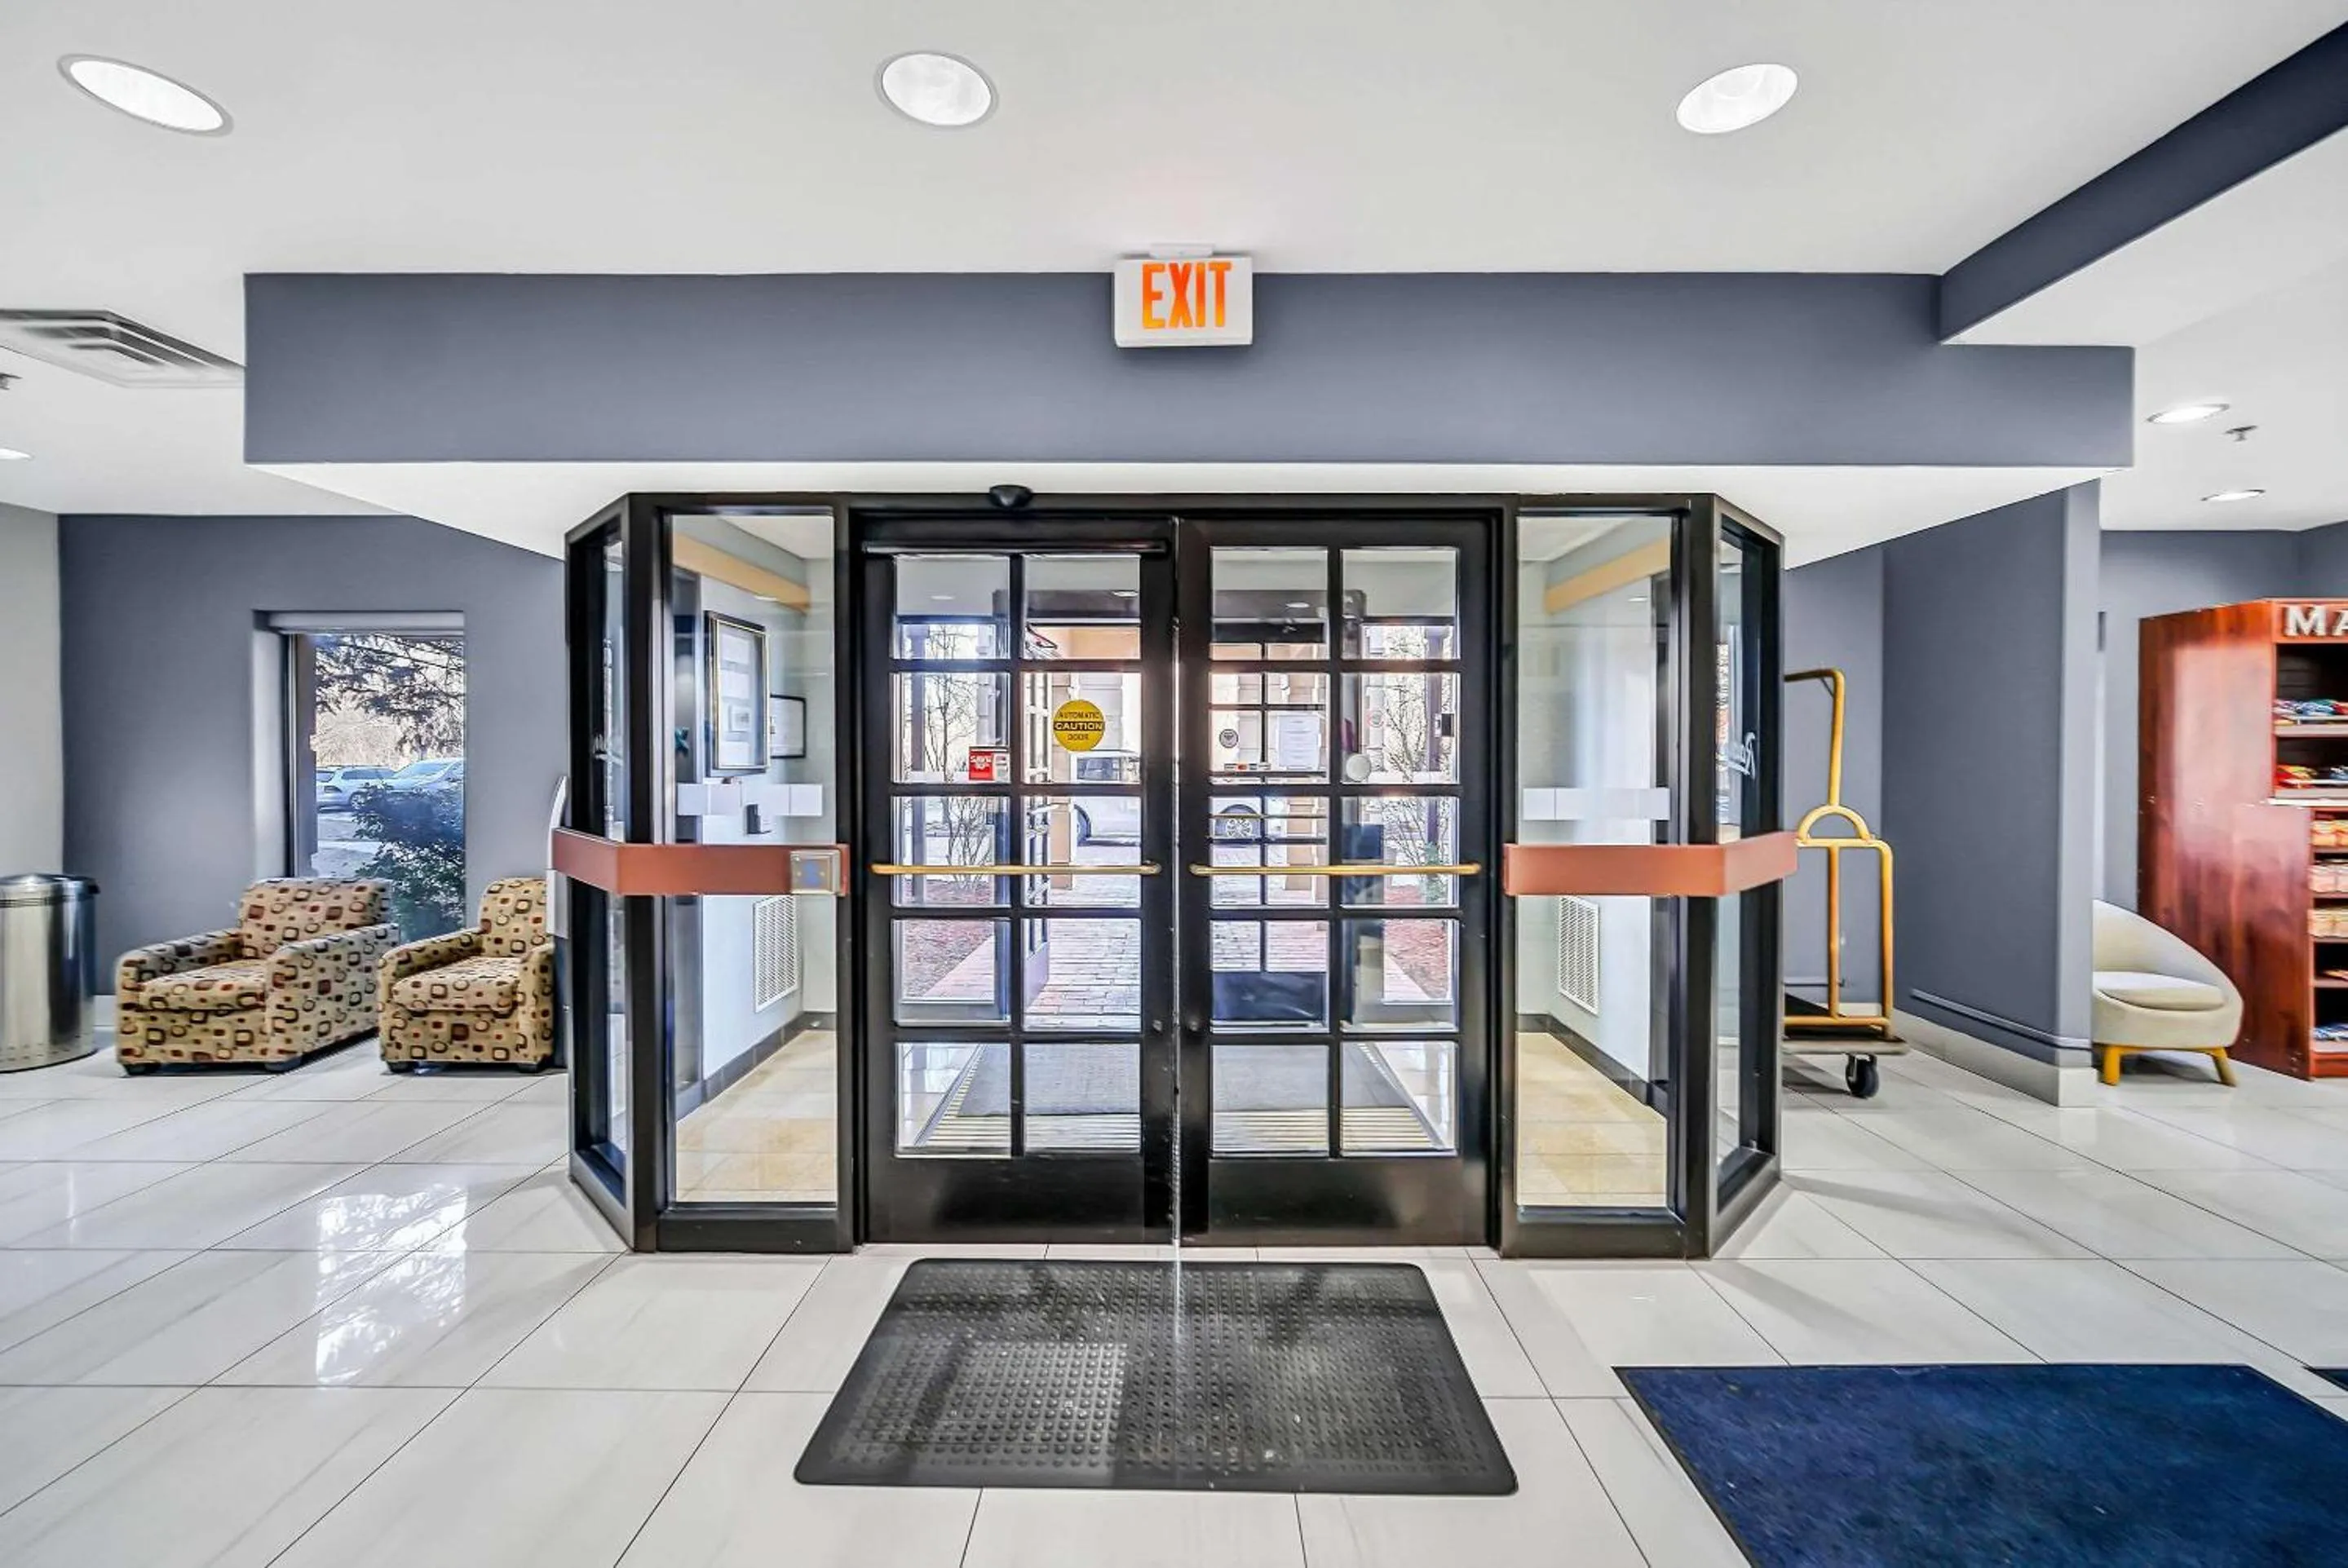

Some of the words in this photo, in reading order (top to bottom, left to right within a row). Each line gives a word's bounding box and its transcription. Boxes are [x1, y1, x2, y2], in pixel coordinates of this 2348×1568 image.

[1143, 262, 1232, 329] EXIT
[1057, 711, 1100, 719] AUTOMATIC
[1055, 722, 1103, 731] CAUTION
